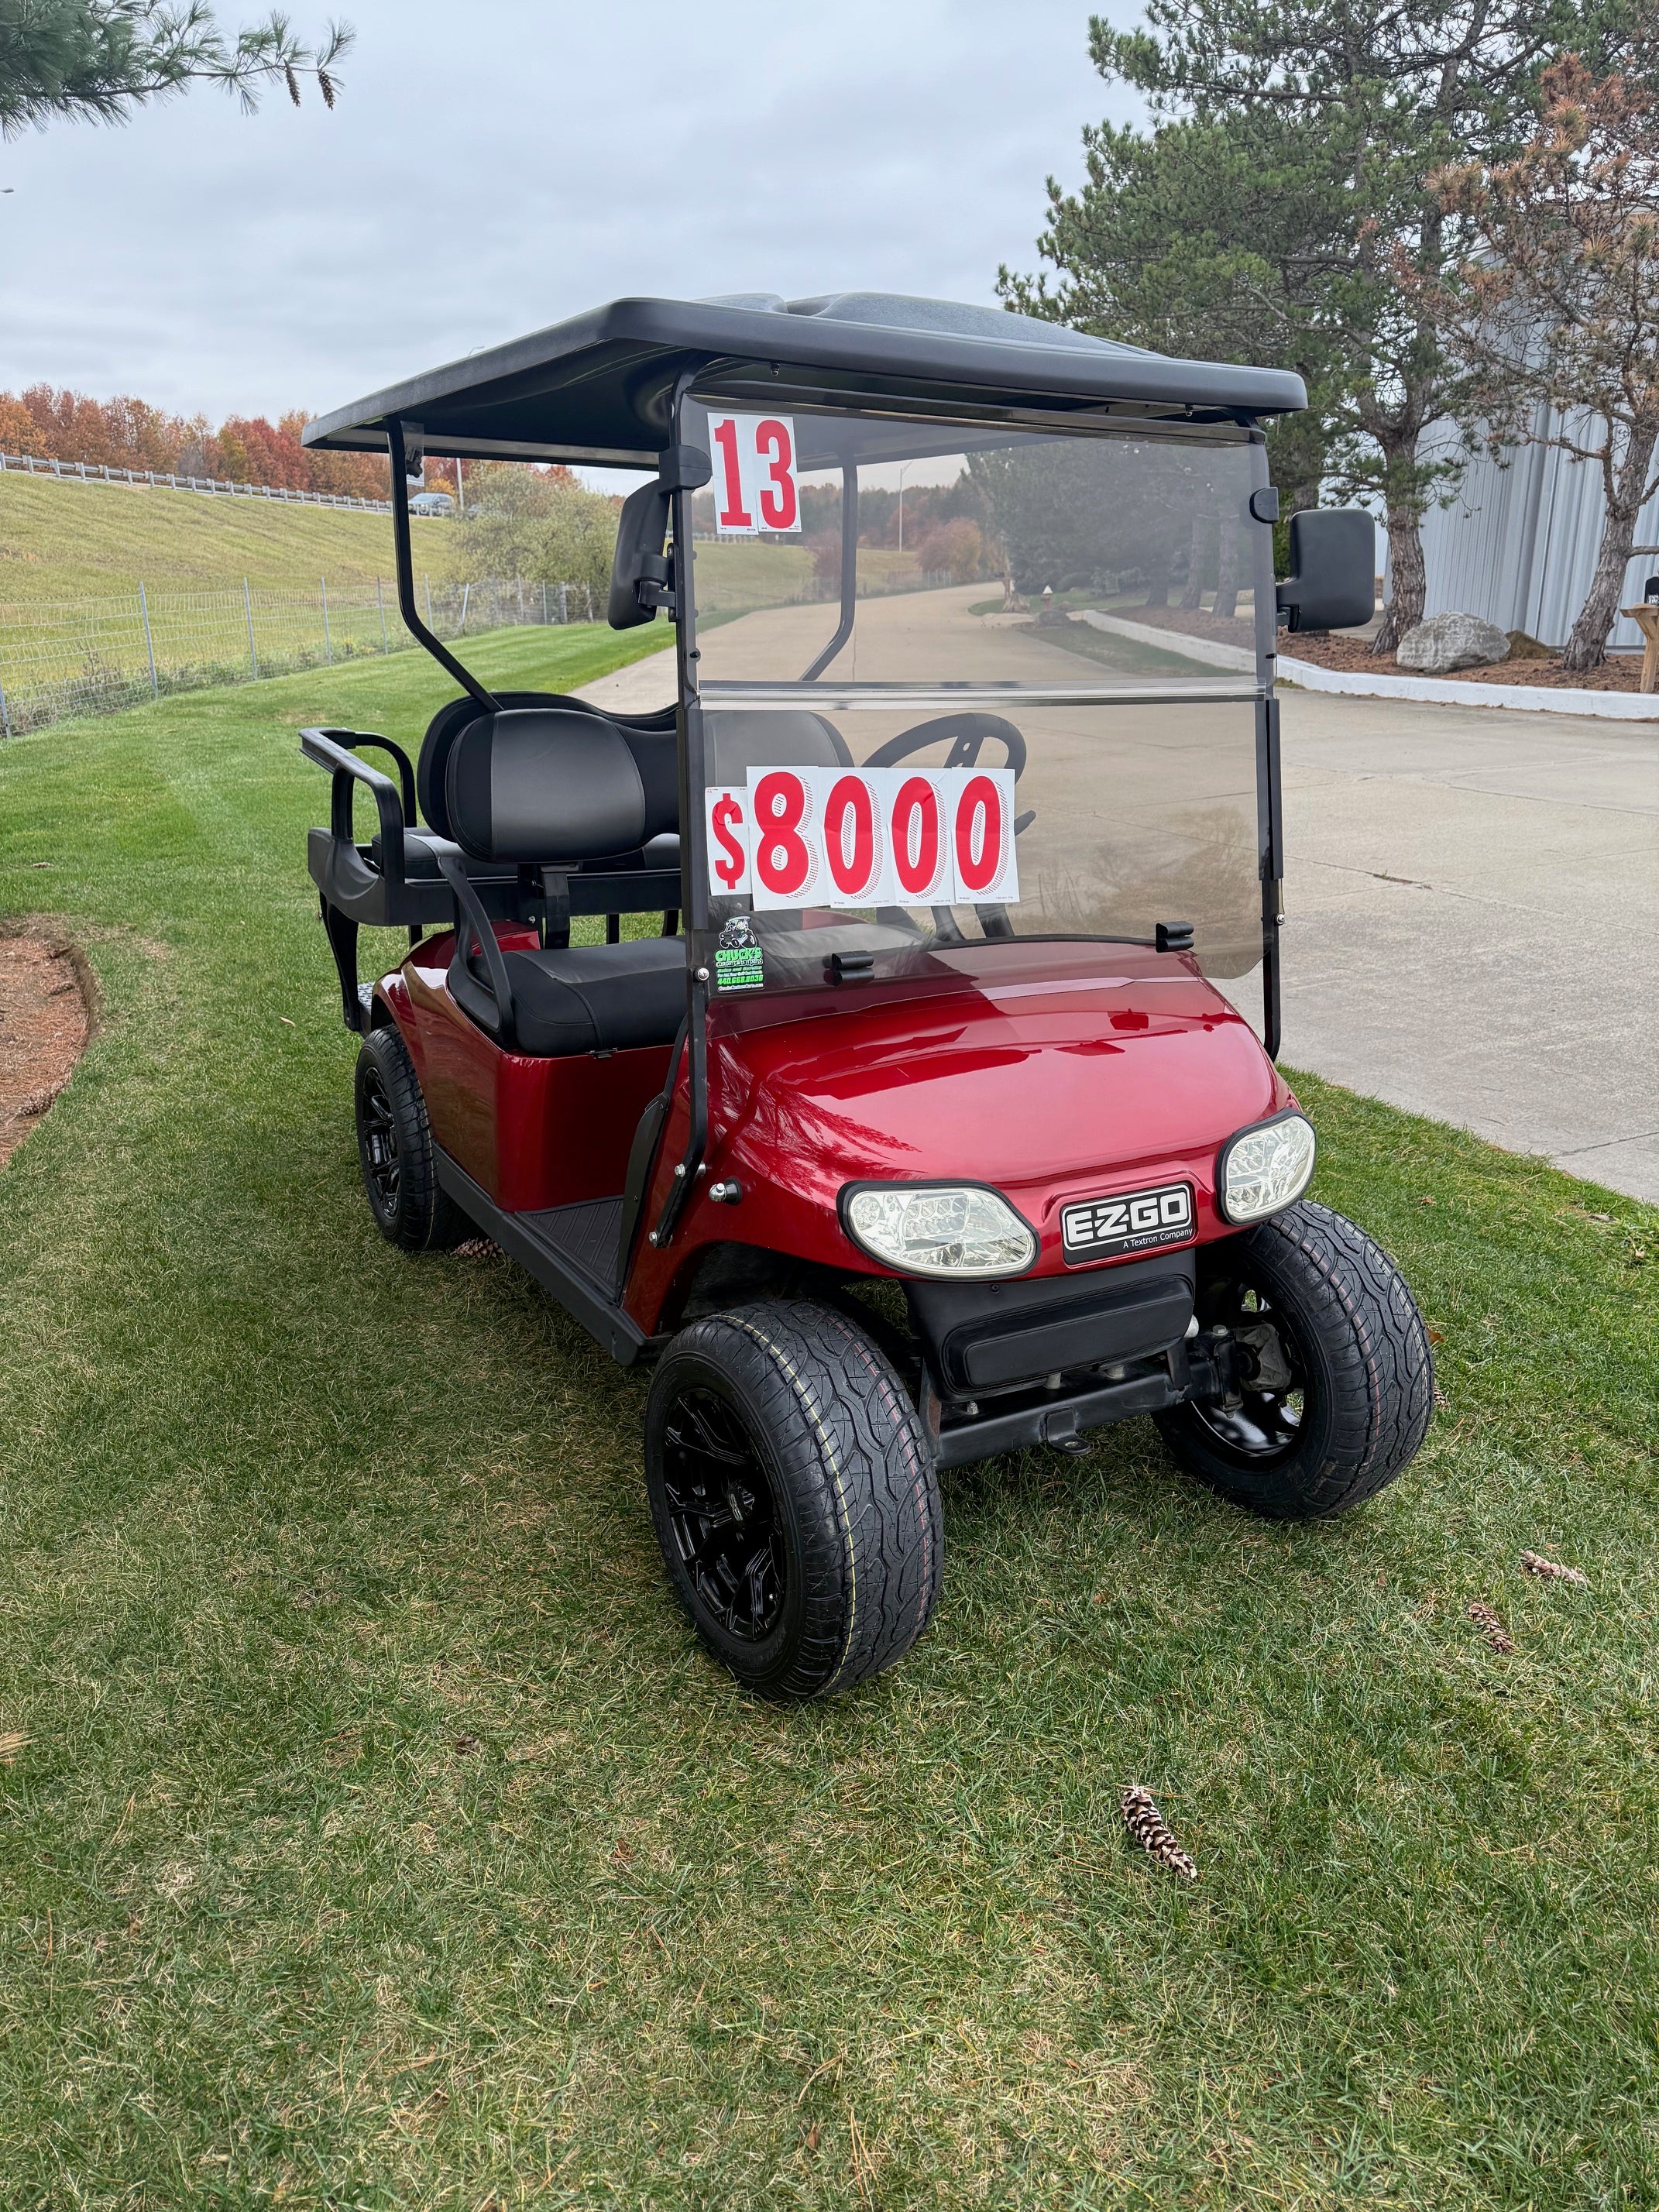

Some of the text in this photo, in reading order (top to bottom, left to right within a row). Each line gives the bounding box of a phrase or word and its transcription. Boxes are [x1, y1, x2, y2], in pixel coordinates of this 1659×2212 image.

[713, 418, 797, 529] 13
[711, 771, 1008, 898] $8000
[715, 946, 763, 961] CHUCK'S
[1130, 1235, 1158, 1247] Textron
[1159, 1228, 1193, 1241] Company
